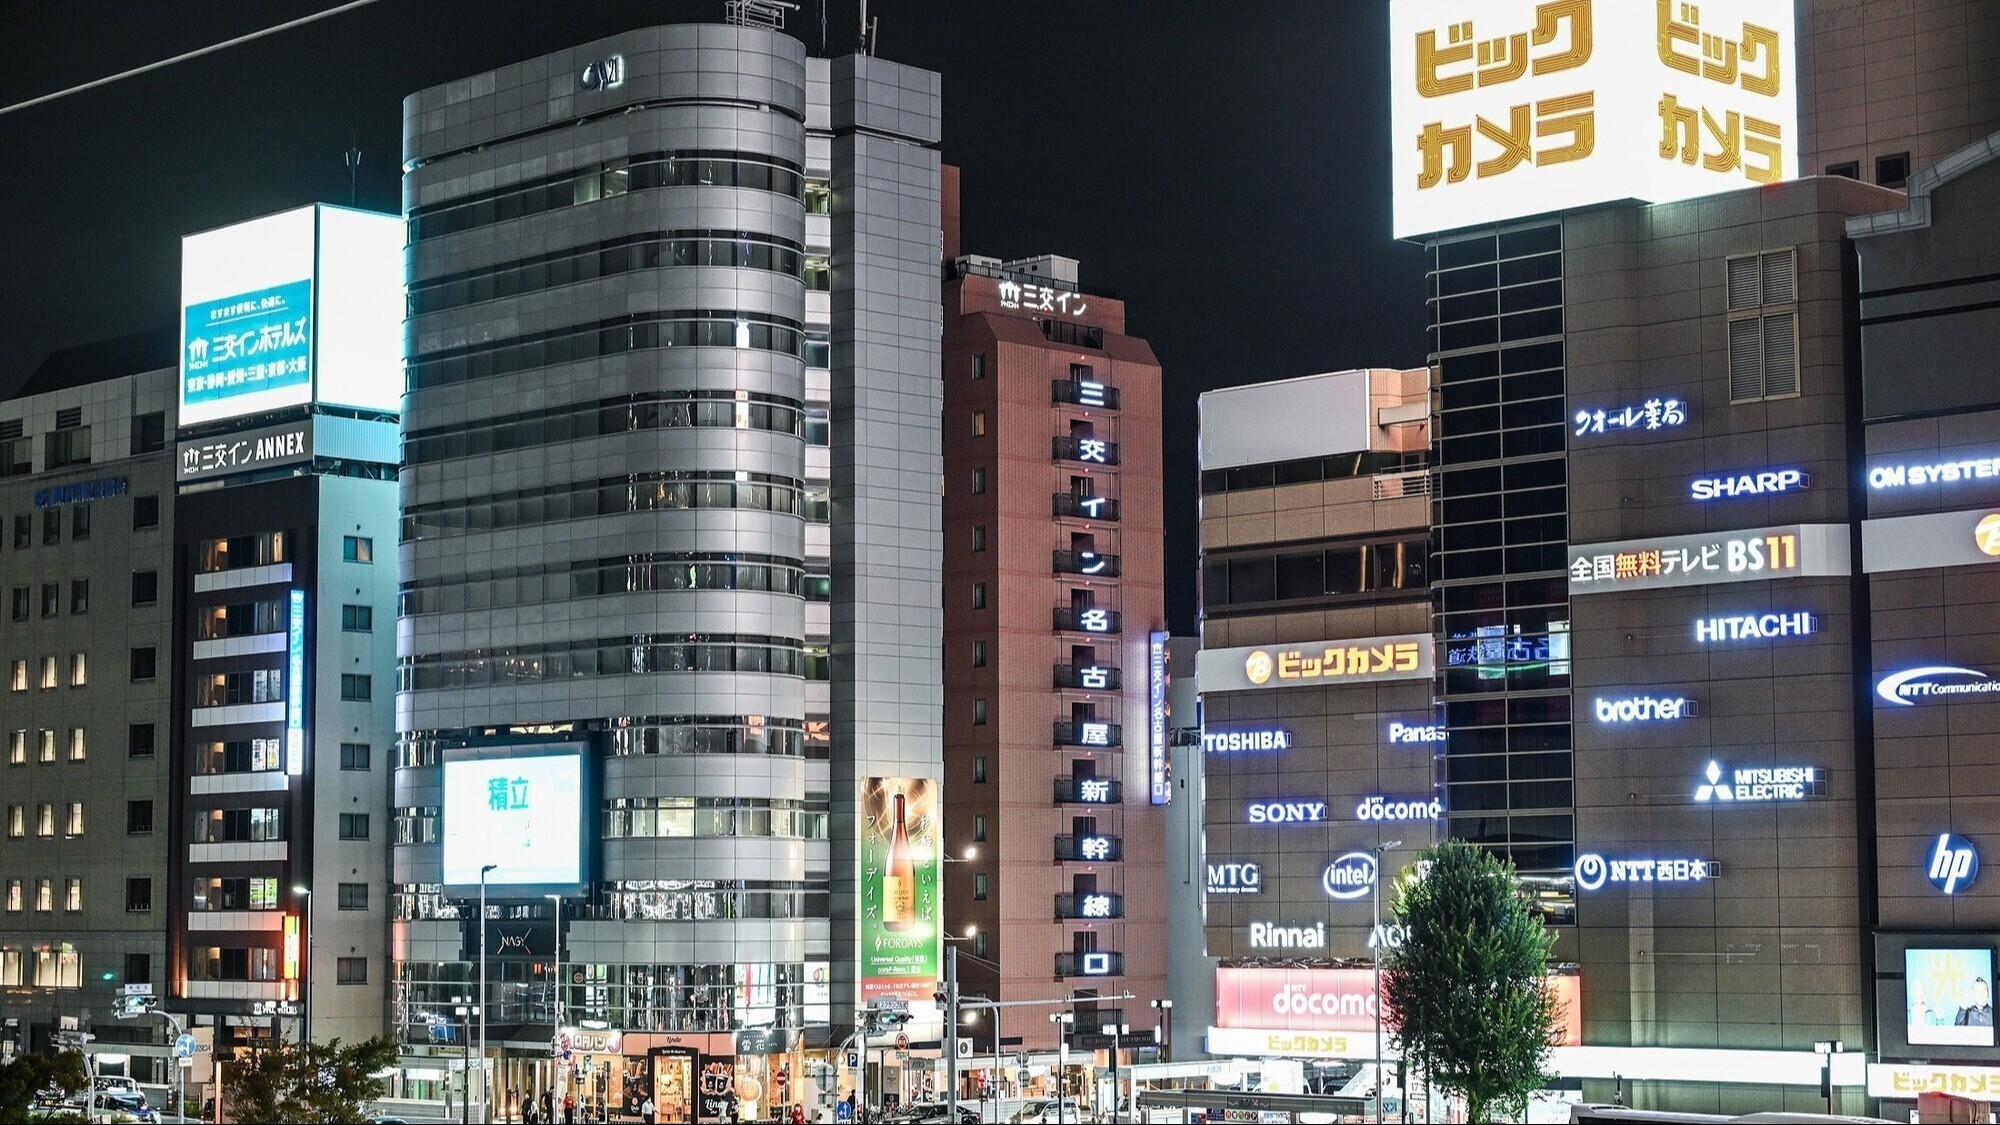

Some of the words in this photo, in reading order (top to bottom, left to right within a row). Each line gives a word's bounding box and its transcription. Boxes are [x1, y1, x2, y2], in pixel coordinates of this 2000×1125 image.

[1415, 0, 1593, 98] ビック
[1657, 0, 1779, 97] ビック
[1416, 90, 1595, 190] カメラ
[1658, 92, 1782, 184] カメラ
[1023, 282, 1087, 316] 三交イン
[202, 441, 252, 470] 三交イン
[255, 431, 305, 461] ANNEX
[1691, 470, 1800, 500] SHARP
[1869, 465, 1906, 489] OM
[1570, 544, 1720, 582] 全国無料テレビ
[1727, 535, 1796, 573] BS11
[1696, 612, 1810, 642] HITACHI
[1278, 642, 1419, 679] ビックカメラ
[1898, 682, 1932, 696] NTT
[1596, 697, 1684, 722] brother
[1204, 731, 1286, 751] TOSHIBA
[1735, 768, 1813, 785] MITSUBISHI
[488, 777, 529, 811] 積立
[1736, 784, 1804, 800] ELECTRIC
[1249, 804, 1324, 823] SONY
[1208, 864, 1258, 885] MTG
[1331, 862, 1370, 886] intel
[1610, 859, 1708, 881] NTT西日本
[1930, 834, 1973, 894] hp
[883, 938, 923, 948] FORDAYS
[1251, 922, 1324, 948] Rinnai
[1268, 1036, 1347, 1052] ビックカメラ
[849, 1055, 857, 1066] P
